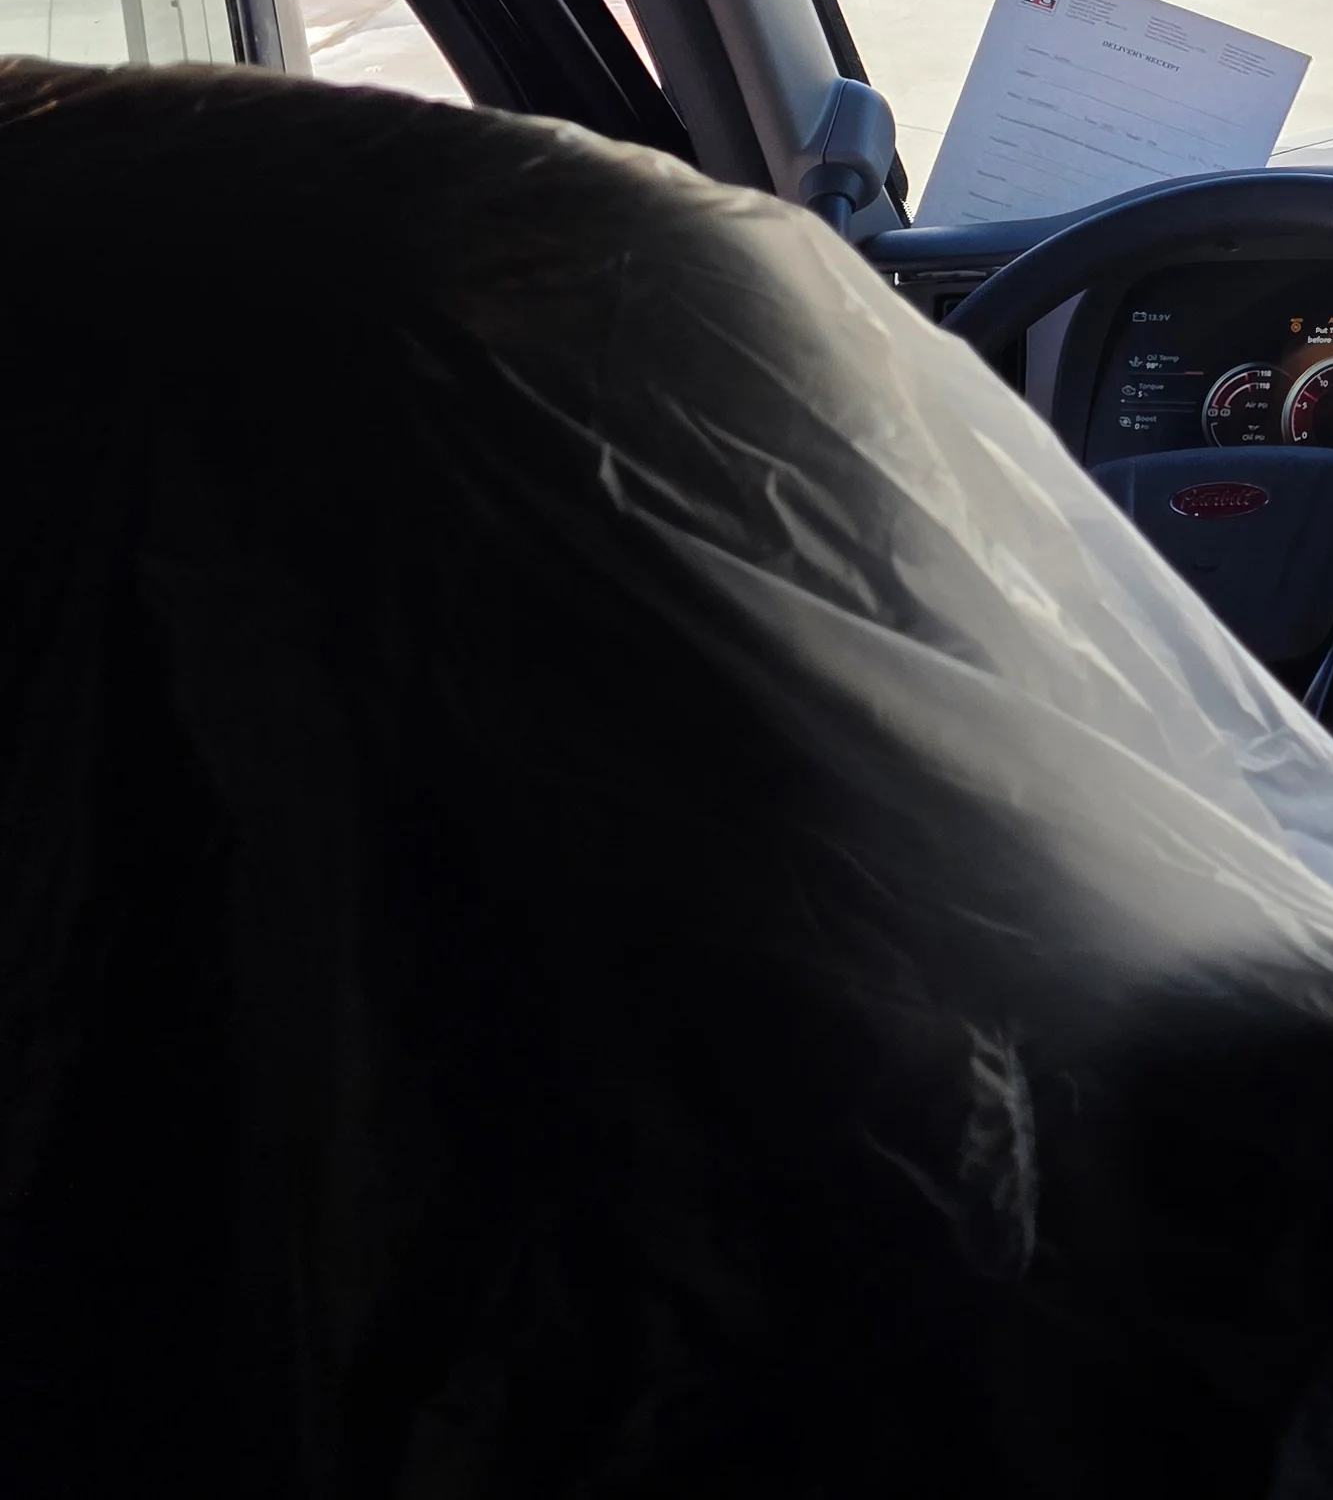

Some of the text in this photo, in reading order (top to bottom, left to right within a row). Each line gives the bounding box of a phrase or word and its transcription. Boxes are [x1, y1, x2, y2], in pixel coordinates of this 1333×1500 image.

[1102, 40, 1181, 73] DELIVERY RECEIPT
[1307, 336, 1332, 344] before
[1159, 354, 1179, 363] Temp
[1138, 383, 1164, 391] Torque
[1320, 380, 1328, 388] 10
[1301, 401, 1308, 410] 5
